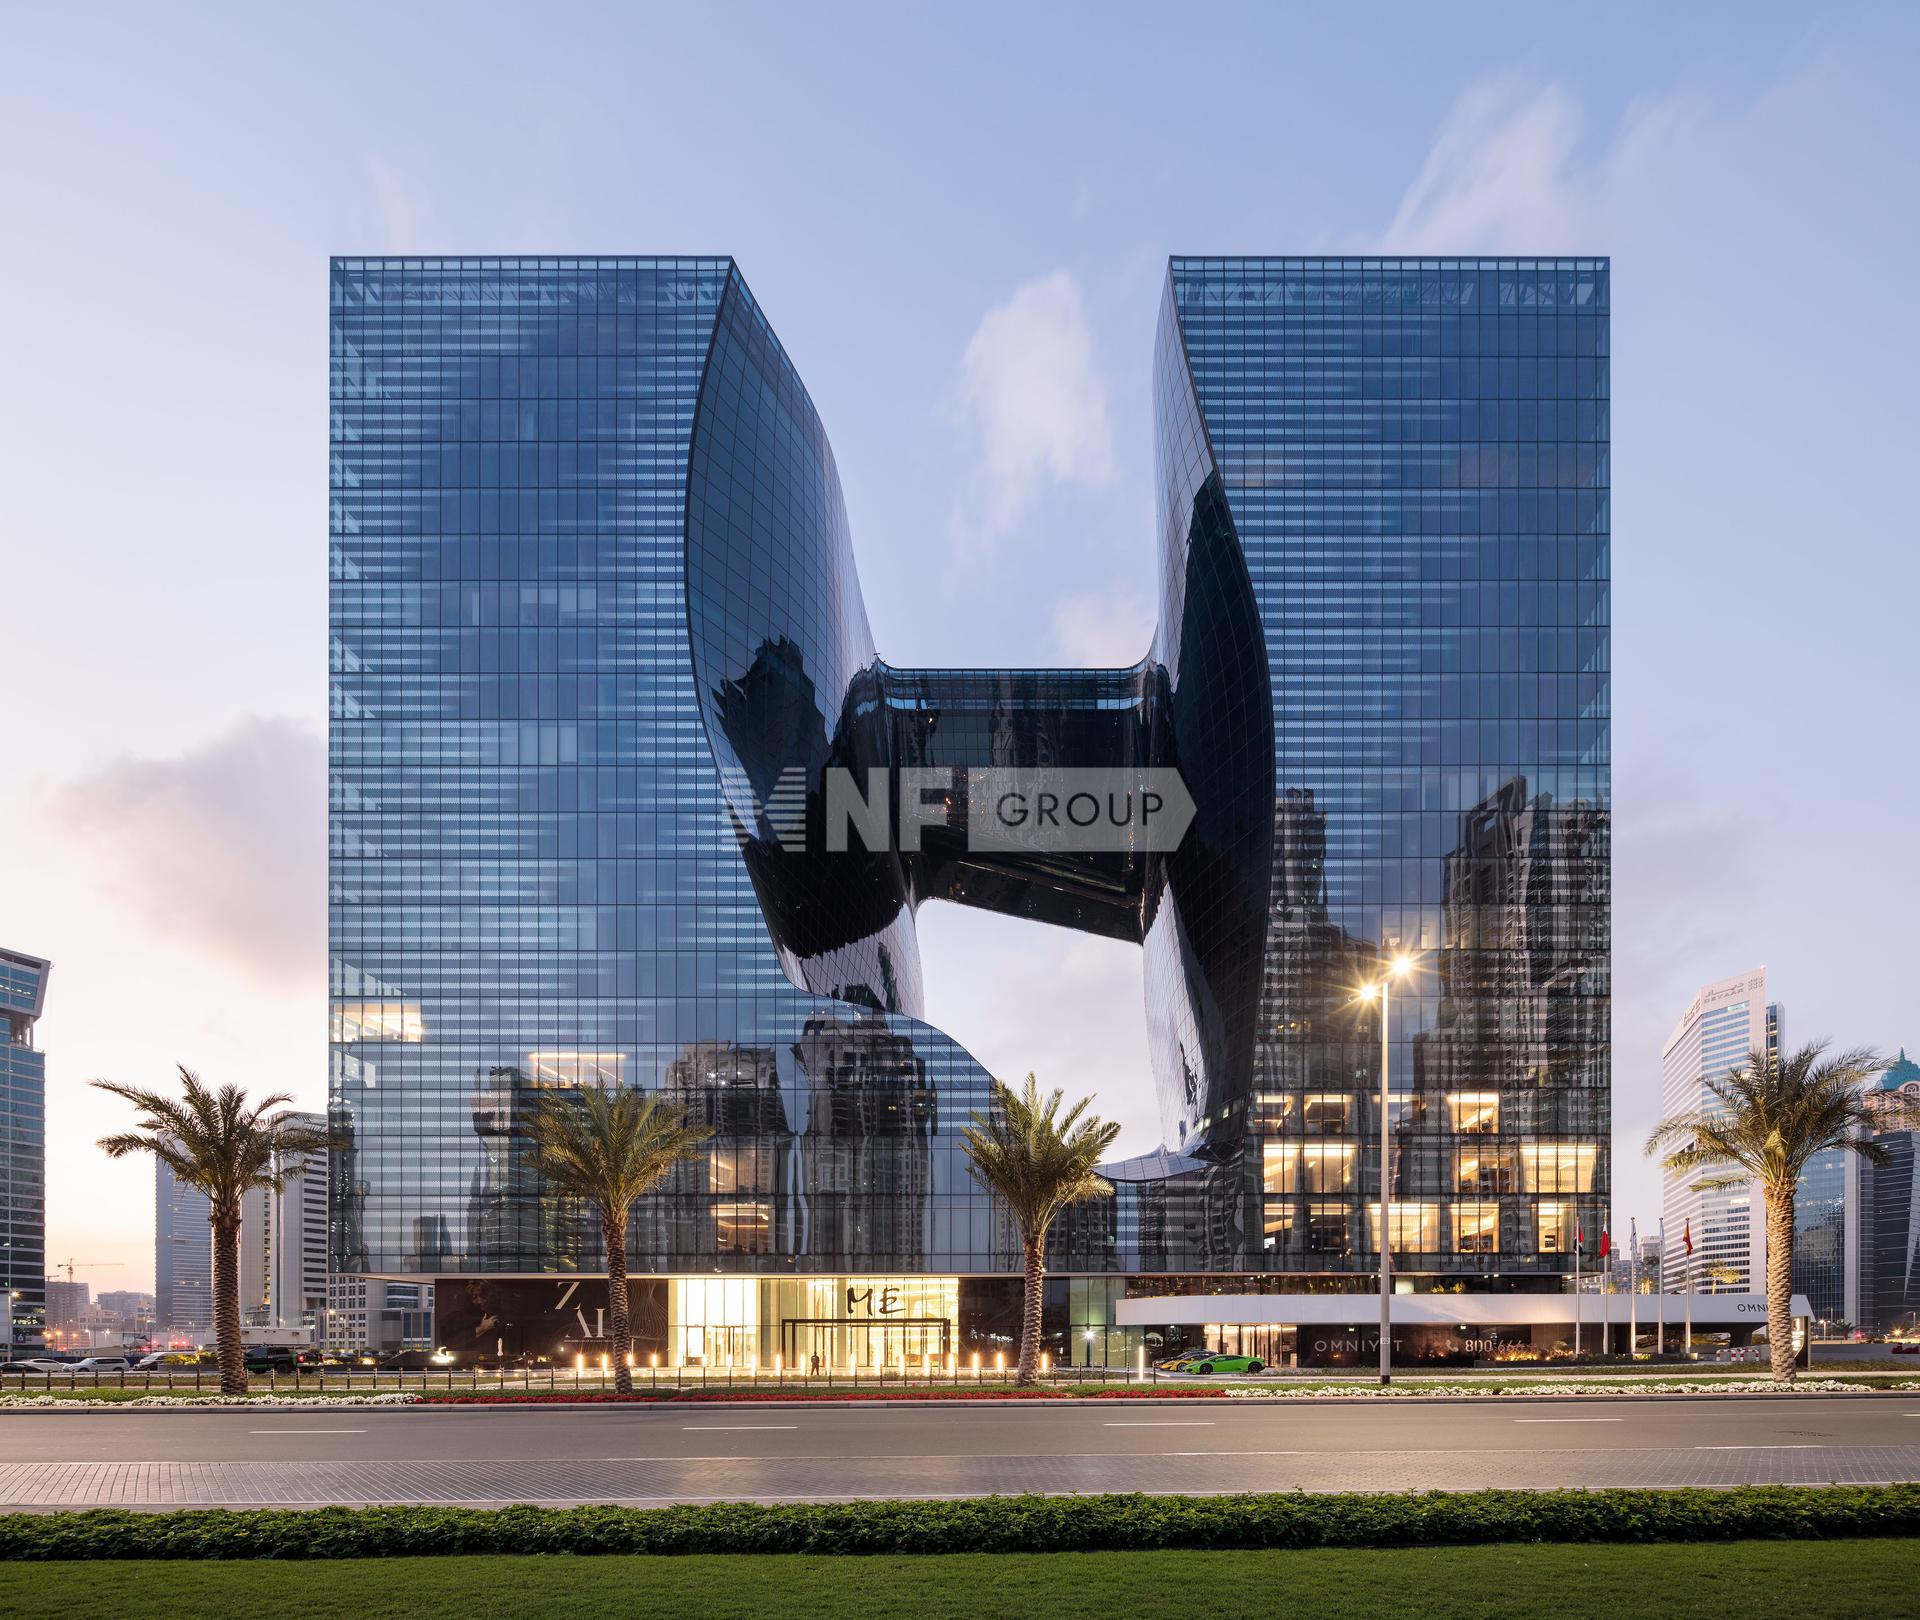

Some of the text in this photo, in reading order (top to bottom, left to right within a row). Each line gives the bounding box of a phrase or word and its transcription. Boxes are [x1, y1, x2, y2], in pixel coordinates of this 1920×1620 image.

[1704, 988, 1745, 1004] DEYAAR
[847, 1287, 906, 1316] ME
[1737, 1303, 1769, 1312] OMNI
[1314, 1340, 1403, 1352] OMNIYT
[1465, 1340, 1493, 1352] 800
